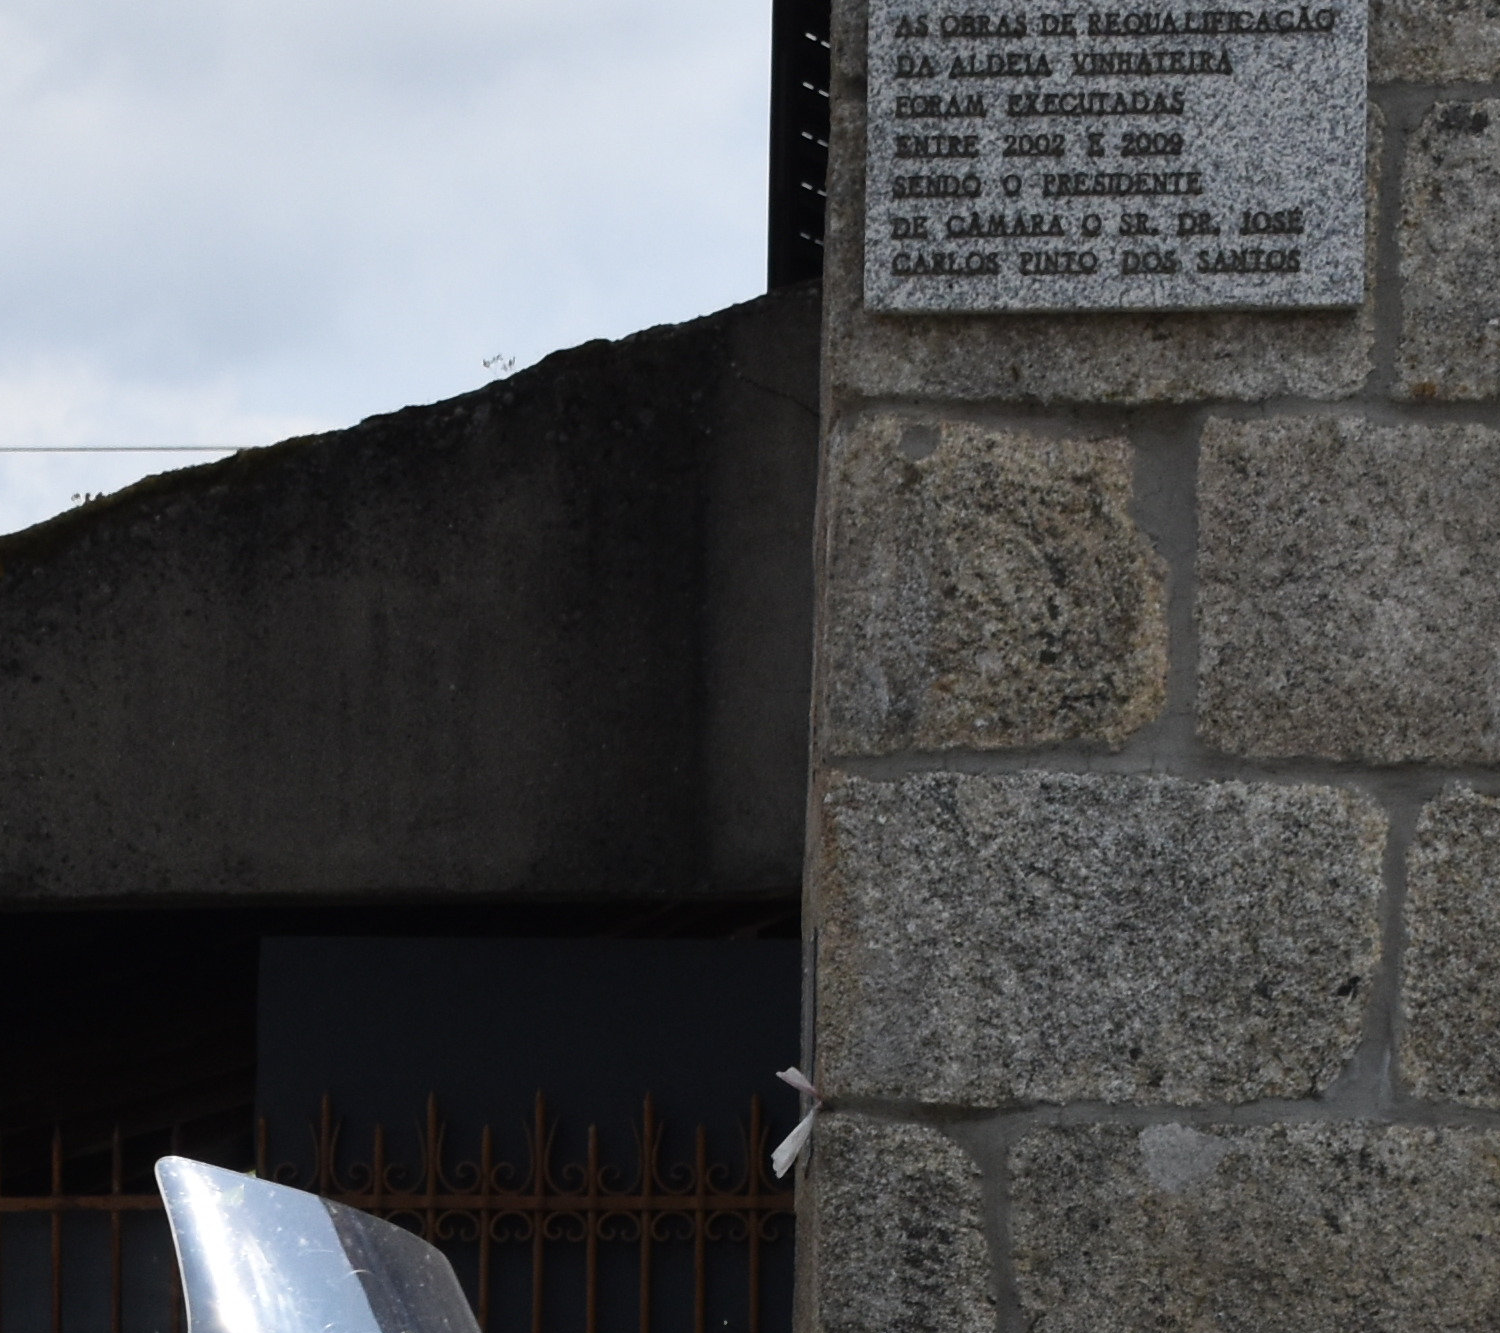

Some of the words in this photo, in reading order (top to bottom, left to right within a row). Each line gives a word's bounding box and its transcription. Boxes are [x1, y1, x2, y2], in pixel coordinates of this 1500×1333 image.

[895, 14, 929, 38] AS
[941, 13, 1028, 38] OBRAS
[1041, 13, 1077, 37] DE
[896, 53, 936, 78] DA
[949, 52, 1053, 78] ALDEIA
[1071, 50, 1234, 76] VINHATEIRA
[895, 95, 987, 118] FORAM
[1006, 91, 1186, 117] EXECUTADAS
[895, 135, 980, 158] ENTRE
[1002, 133, 1066, 157] 2002
[1088, 132, 1105, 157] E
[1121, 132, 1185, 157] 2009
[892, 174, 983, 199] SENDO
[1003, 174, 1023, 197] O
[1042, 172, 1203, 197] PRESIDENTE
[891, 216, 928, 239] DE
[1080, 213, 1102, 237] O
[1119, 213, 1159, 236] SR.
[1176, 211, 1221, 236] DR.
[891, 252, 999, 276] CARLOS
[1019, 251, 1099, 276] PINTO
[1121, 251, 1177, 275] DOS
[1196, 250, 1302, 273] SANTOS
